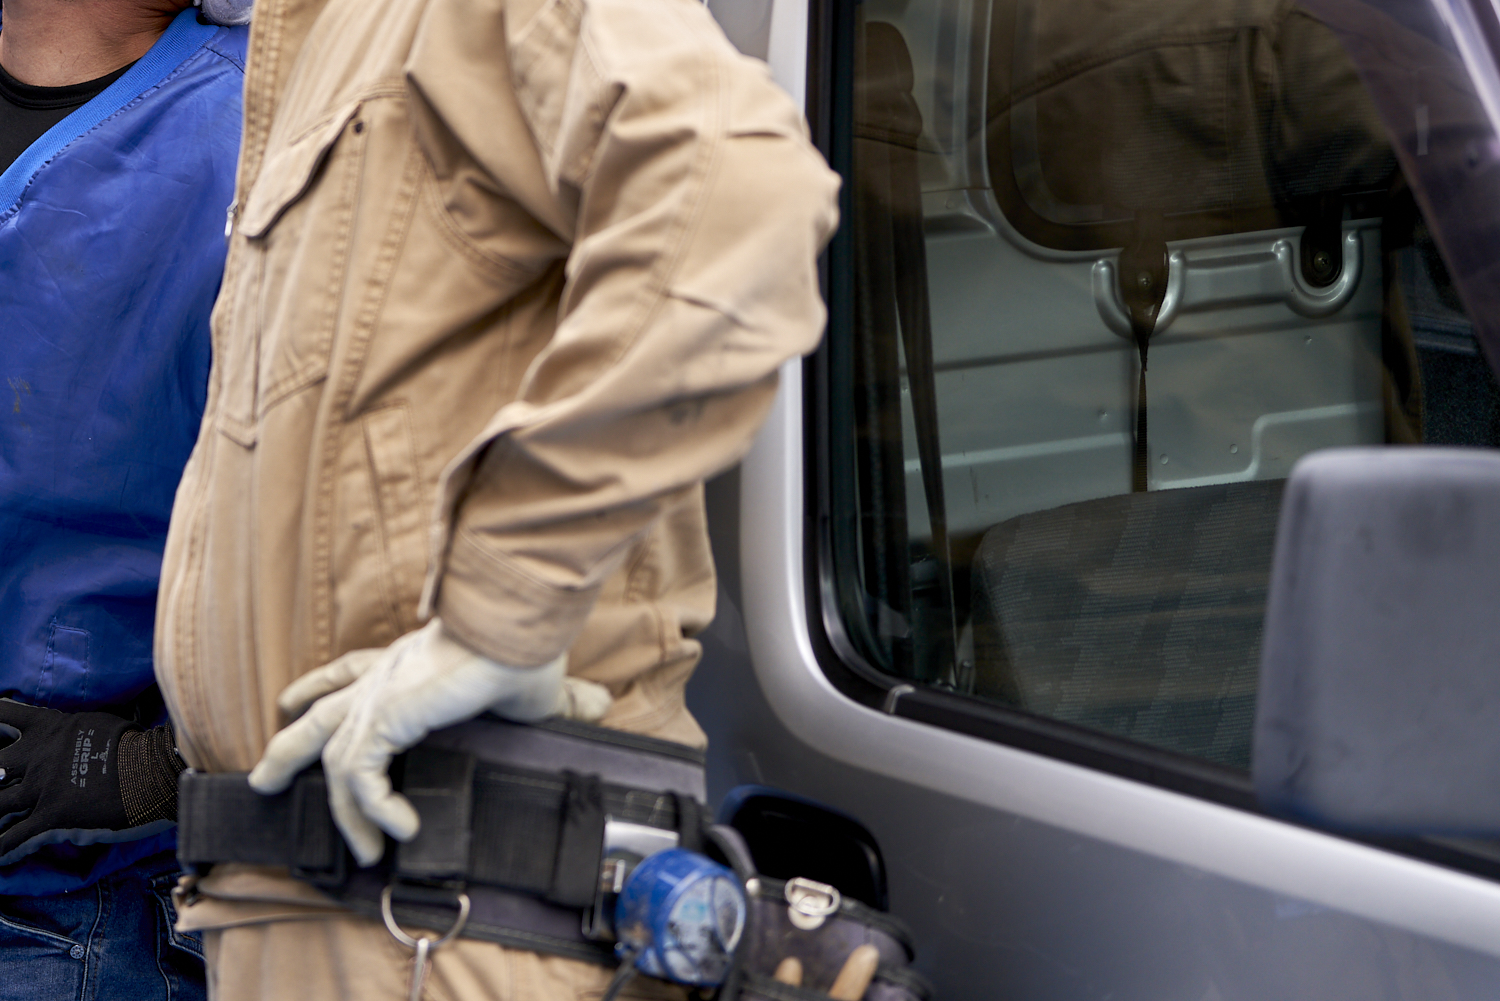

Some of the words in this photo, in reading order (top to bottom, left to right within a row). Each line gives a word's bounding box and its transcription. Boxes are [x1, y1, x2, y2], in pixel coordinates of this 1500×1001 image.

[71, 729, 85, 785] ASSEMBLY
[79, 737, 91, 775] GRIP
[90, 752, 99, 760] L
